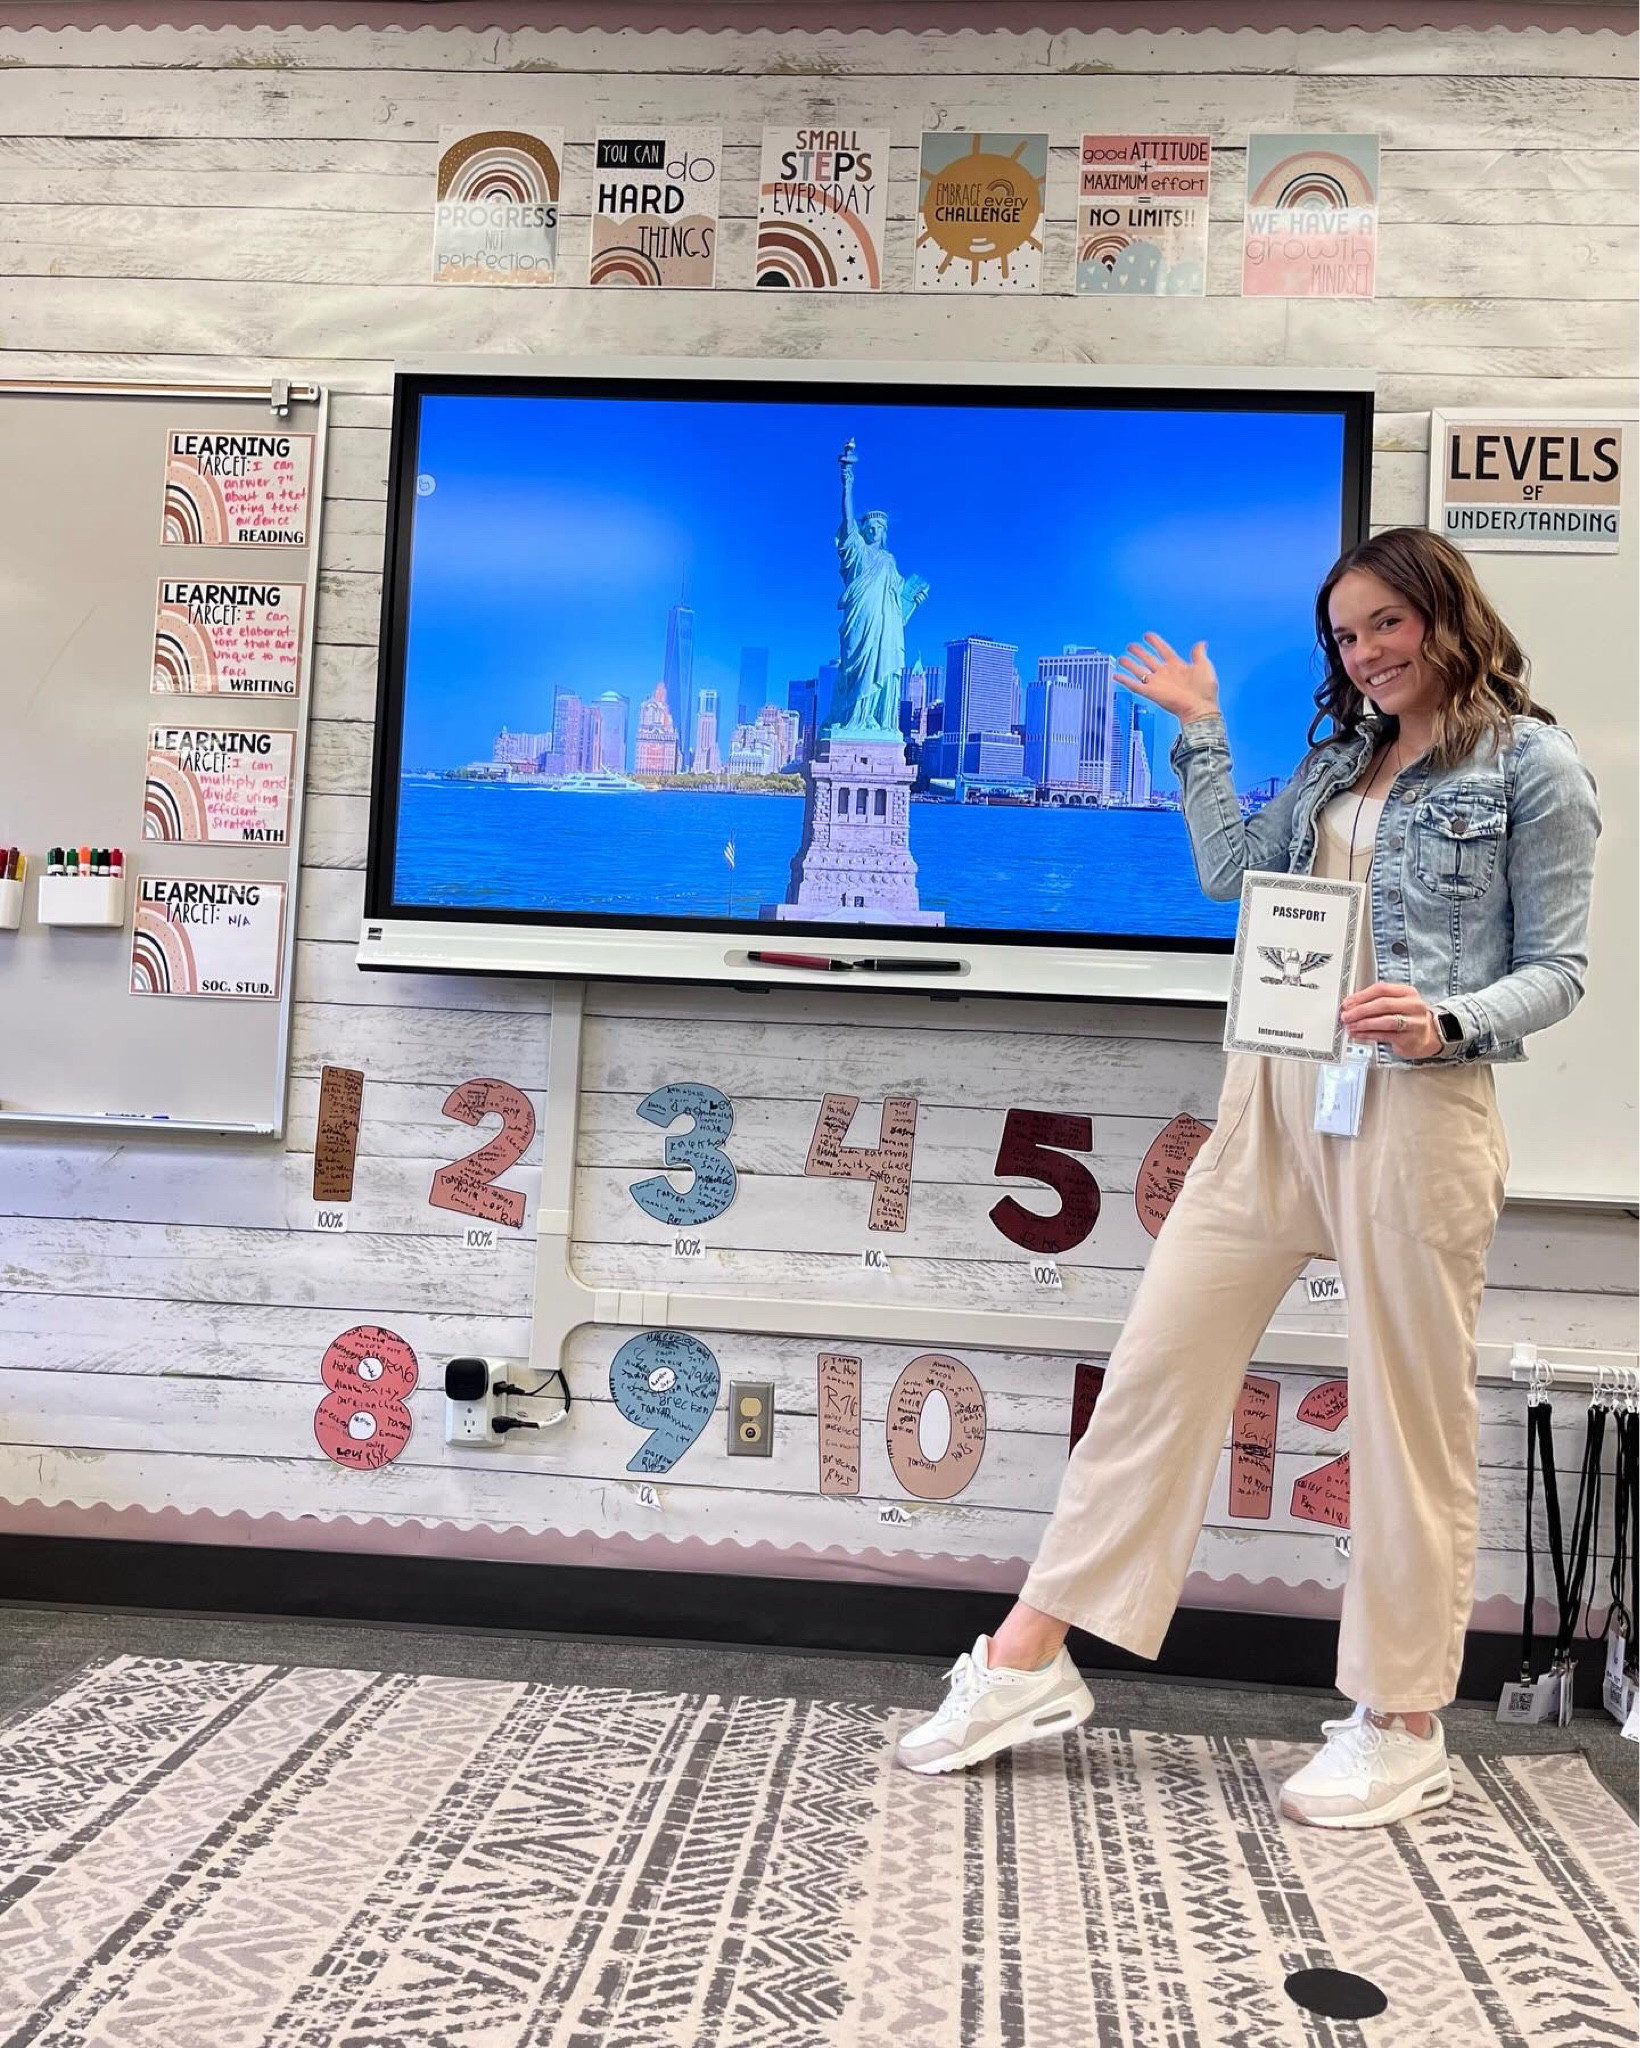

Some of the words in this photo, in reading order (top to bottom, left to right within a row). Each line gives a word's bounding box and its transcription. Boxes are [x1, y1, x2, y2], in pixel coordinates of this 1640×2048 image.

[795, 130, 861, 151] SMALL
[602, 144, 628, 164] YOU
[634, 144, 660, 164] CAN
[1083, 147, 1128, 164] good
[1130, 141, 1209, 162] ATTITUDE
[666, 152, 716, 183] do
[780, 151, 873, 182] STEPS
[1083, 173, 1149, 191] MAXIMUM
[1151, 175, 1205, 192] effort
[598, 183, 685, 214] HARD
[773, 182, 876, 215] EVERYDAY
[935, 182, 982, 207] EMBRACE
[984, 195, 1029, 211] every
[437, 206, 557, 229] PROGRESS
[935, 206, 1021, 223] CHALLENGE
[1089, 208, 1121, 228] NO
[1128, 208, 1196, 229] LIMITS!!
[1250, 212, 1281, 235] WE
[1290, 213, 1349, 236] HAVE
[1358, 213, 1375, 236] A
[485, 231, 505, 249] NOT
[638, 225, 715, 259] THINGS
[1245, 236, 1373, 265] growth
[438, 250, 551, 272] perfection
[1311, 263, 1370, 295] MINDSET
[173, 435, 290, 458] LEARNING
[197, 455, 252, 477] TARGET:
[252, 461, 263, 472] I
[273, 460, 294, 471] can
[1450, 434, 1619, 483] LEVELS
[223, 478, 270, 490] answer
[1522, 484, 1545, 501] OF
[225, 490, 258, 503] about
[265, 491, 275, 500] a
[280, 487, 306, 500] text
[228, 502, 265, 516] citing
[271, 502, 300, 513] text
[1447, 510, 1617, 533] UNDERSTANDING
[238, 528, 304, 544] READING
[164, 583, 281, 607] LEARNING
[187, 604, 241, 626] TARGET:
[245, 610, 256, 621] I
[265, 611, 290, 621] can
[212, 627, 232, 637] use
[243, 638, 271, 649] that
[275, 640, 295, 650] are
[212, 650, 256, 663] unique
[262, 652, 274, 661] to
[279, 653, 297, 666] my
[230, 679, 295, 694] WRITING
[154, 730, 271, 755] LEARNING
[177, 751, 231, 774] TARGET:
[231, 758, 241, 768] I
[251, 760, 273, 771] can
[200, 774, 256, 789] multiply
[262, 776, 287, 790] and
[202, 788, 239, 803] divide
[246, 791, 279, 807] using
[207, 803, 258, 818] efficient
[242, 828, 284, 842] MATH
[142, 880, 260, 907] LEARNING
[165, 902, 220, 925] TARGET:
[228, 913, 251, 928] N/A
[1272, 904, 1327, 923] PASSPORT
[201, 979, 231, 993] SOC.
[235, 981, 273, 995] STUD.
[1258, 1026, 1304, 1040] International
[429, 1078, 537, 1230] 2
[629, 1081, 738, 1227] 3
[804, 1093, 920, 1233] 4
[988, 1108, 1101, 1255] 5
[317, 1210, 344, 1228] 100%
[466, 1230, 493, 1247] 100%
[674, 1239, 702, 1256] 100%
[1033, 1265, 1060, 1286] 100%
[1309, 1278, 1340, 1298] 100%
[314, 1325, 419, 1472] 8
[609, 1330, 721, 1474] 9
[816, 1352, 987, 1501] 10
